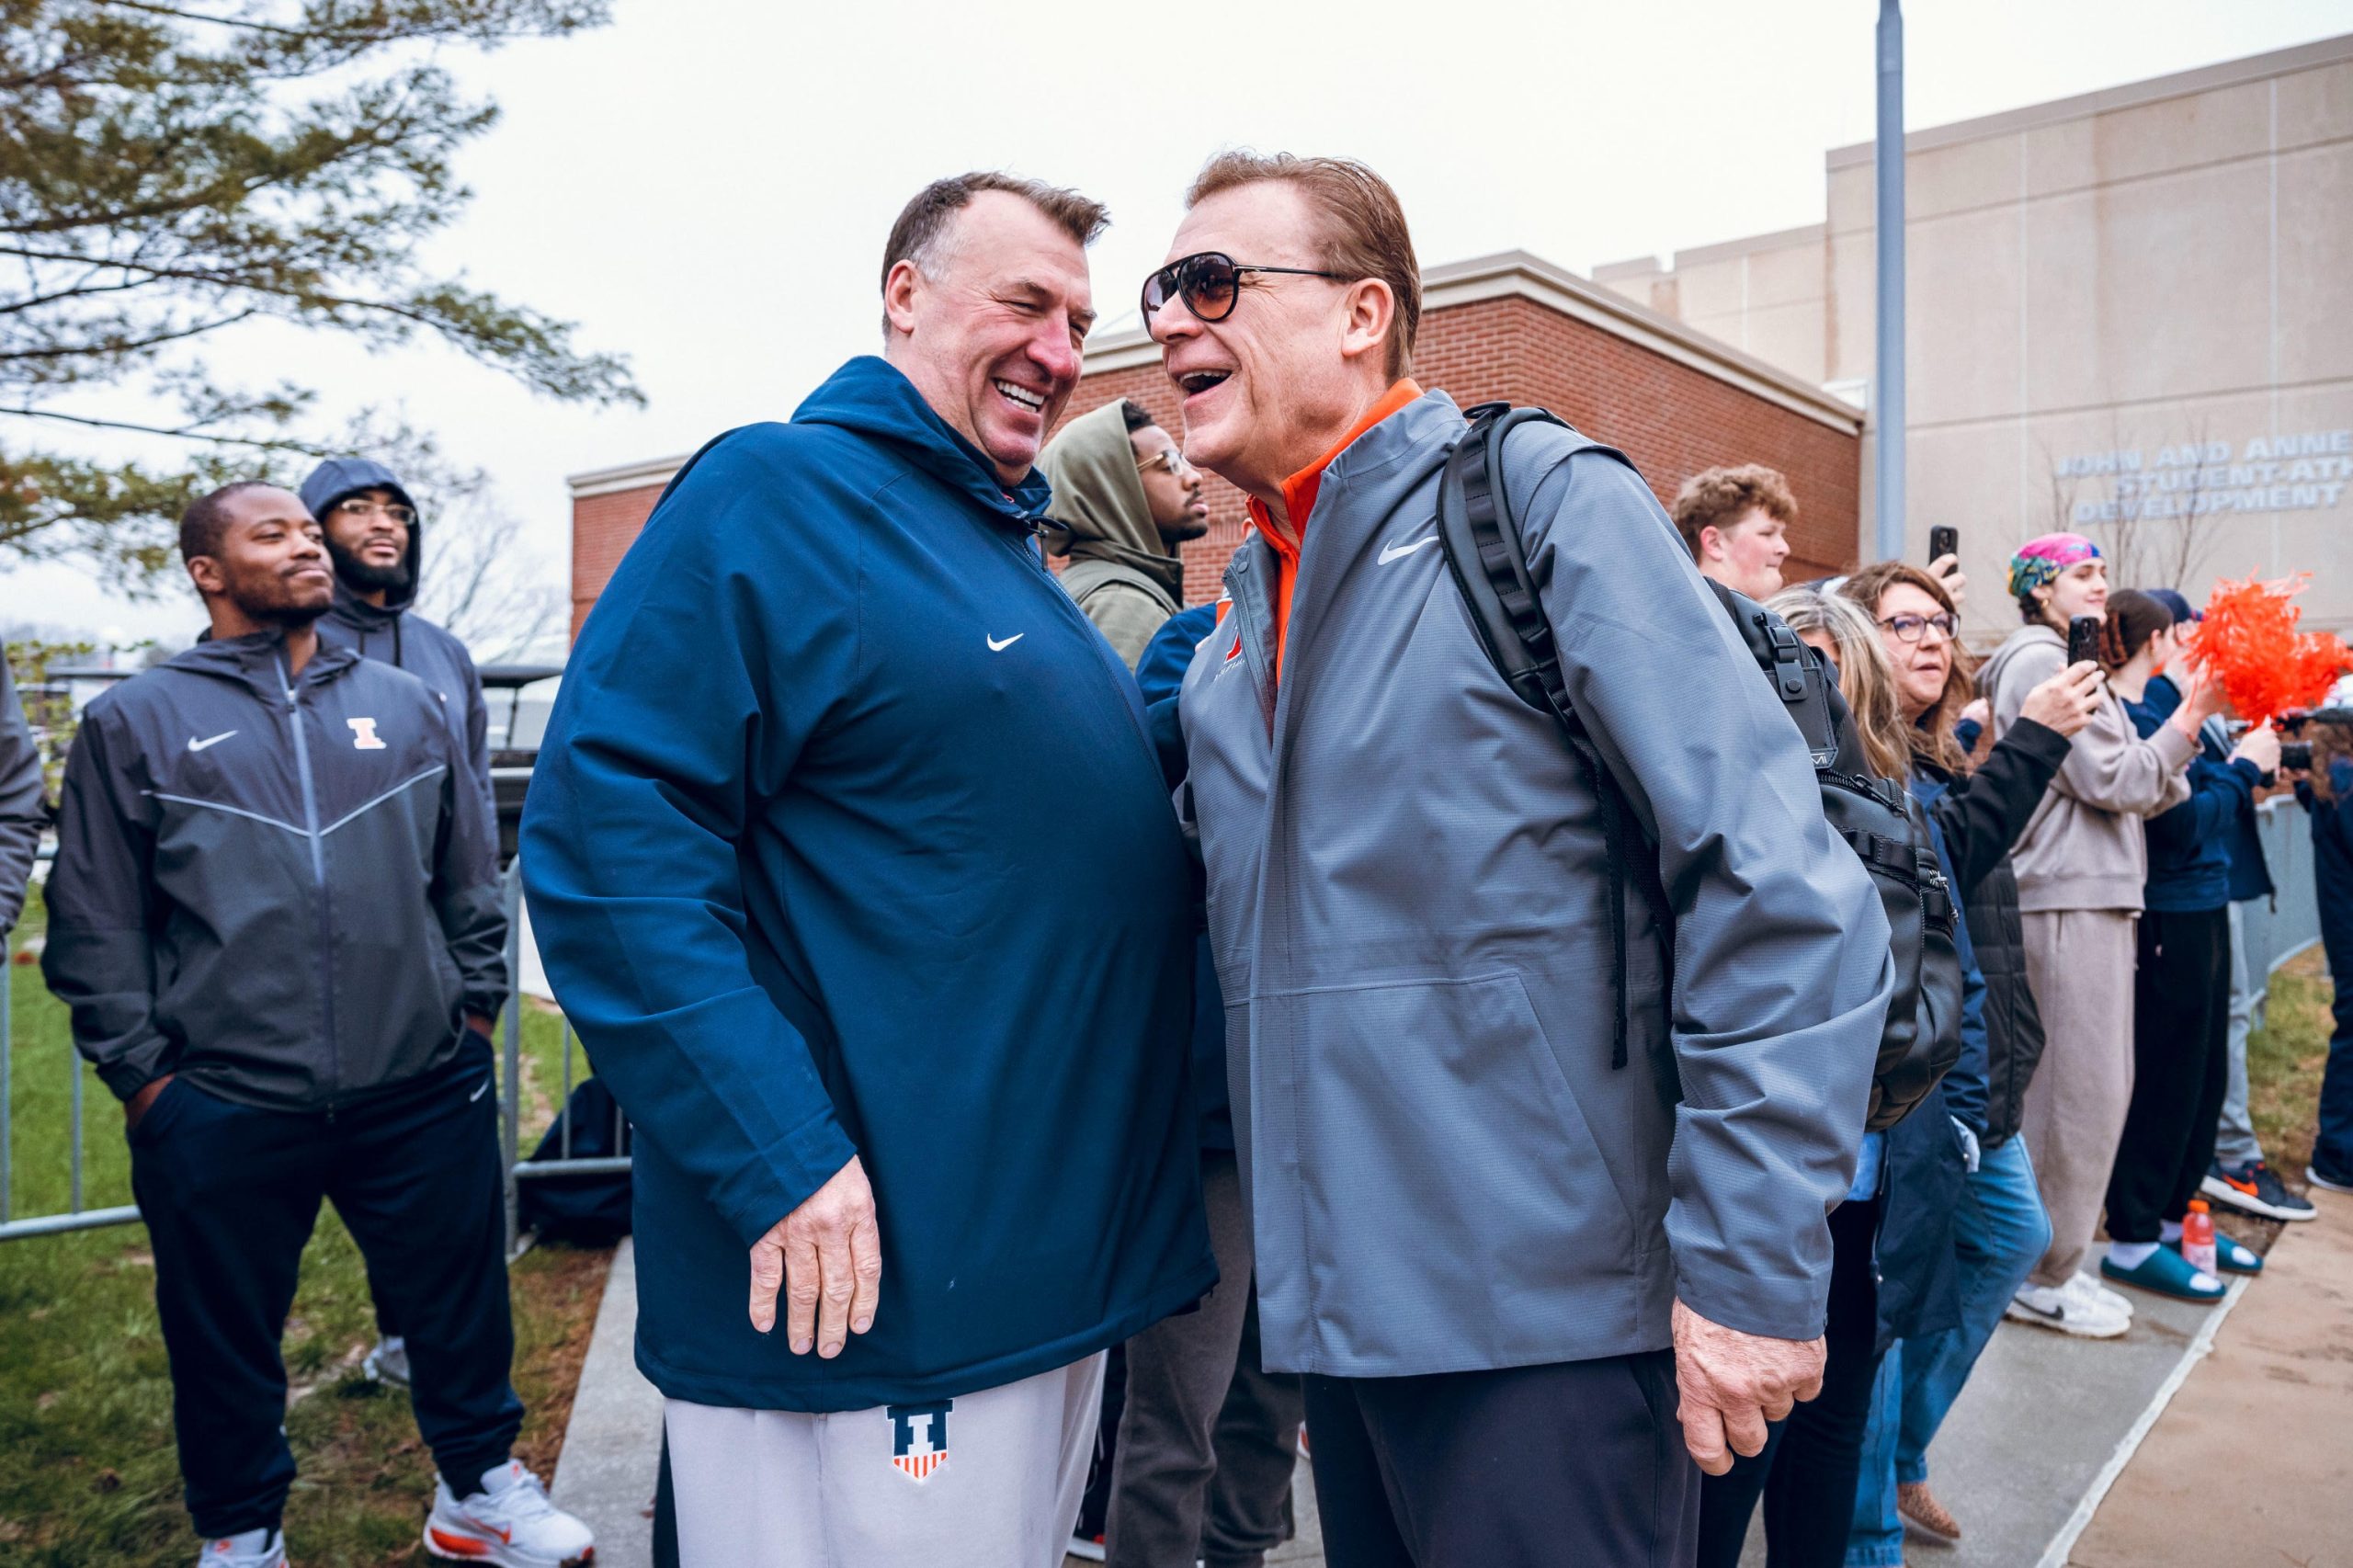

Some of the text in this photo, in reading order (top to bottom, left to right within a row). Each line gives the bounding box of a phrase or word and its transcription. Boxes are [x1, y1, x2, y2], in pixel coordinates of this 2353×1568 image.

[2056, 431, 2351, 476] JOHN AND ANNE
[2074, 483, 2344, 523] DEVELOPMENT
